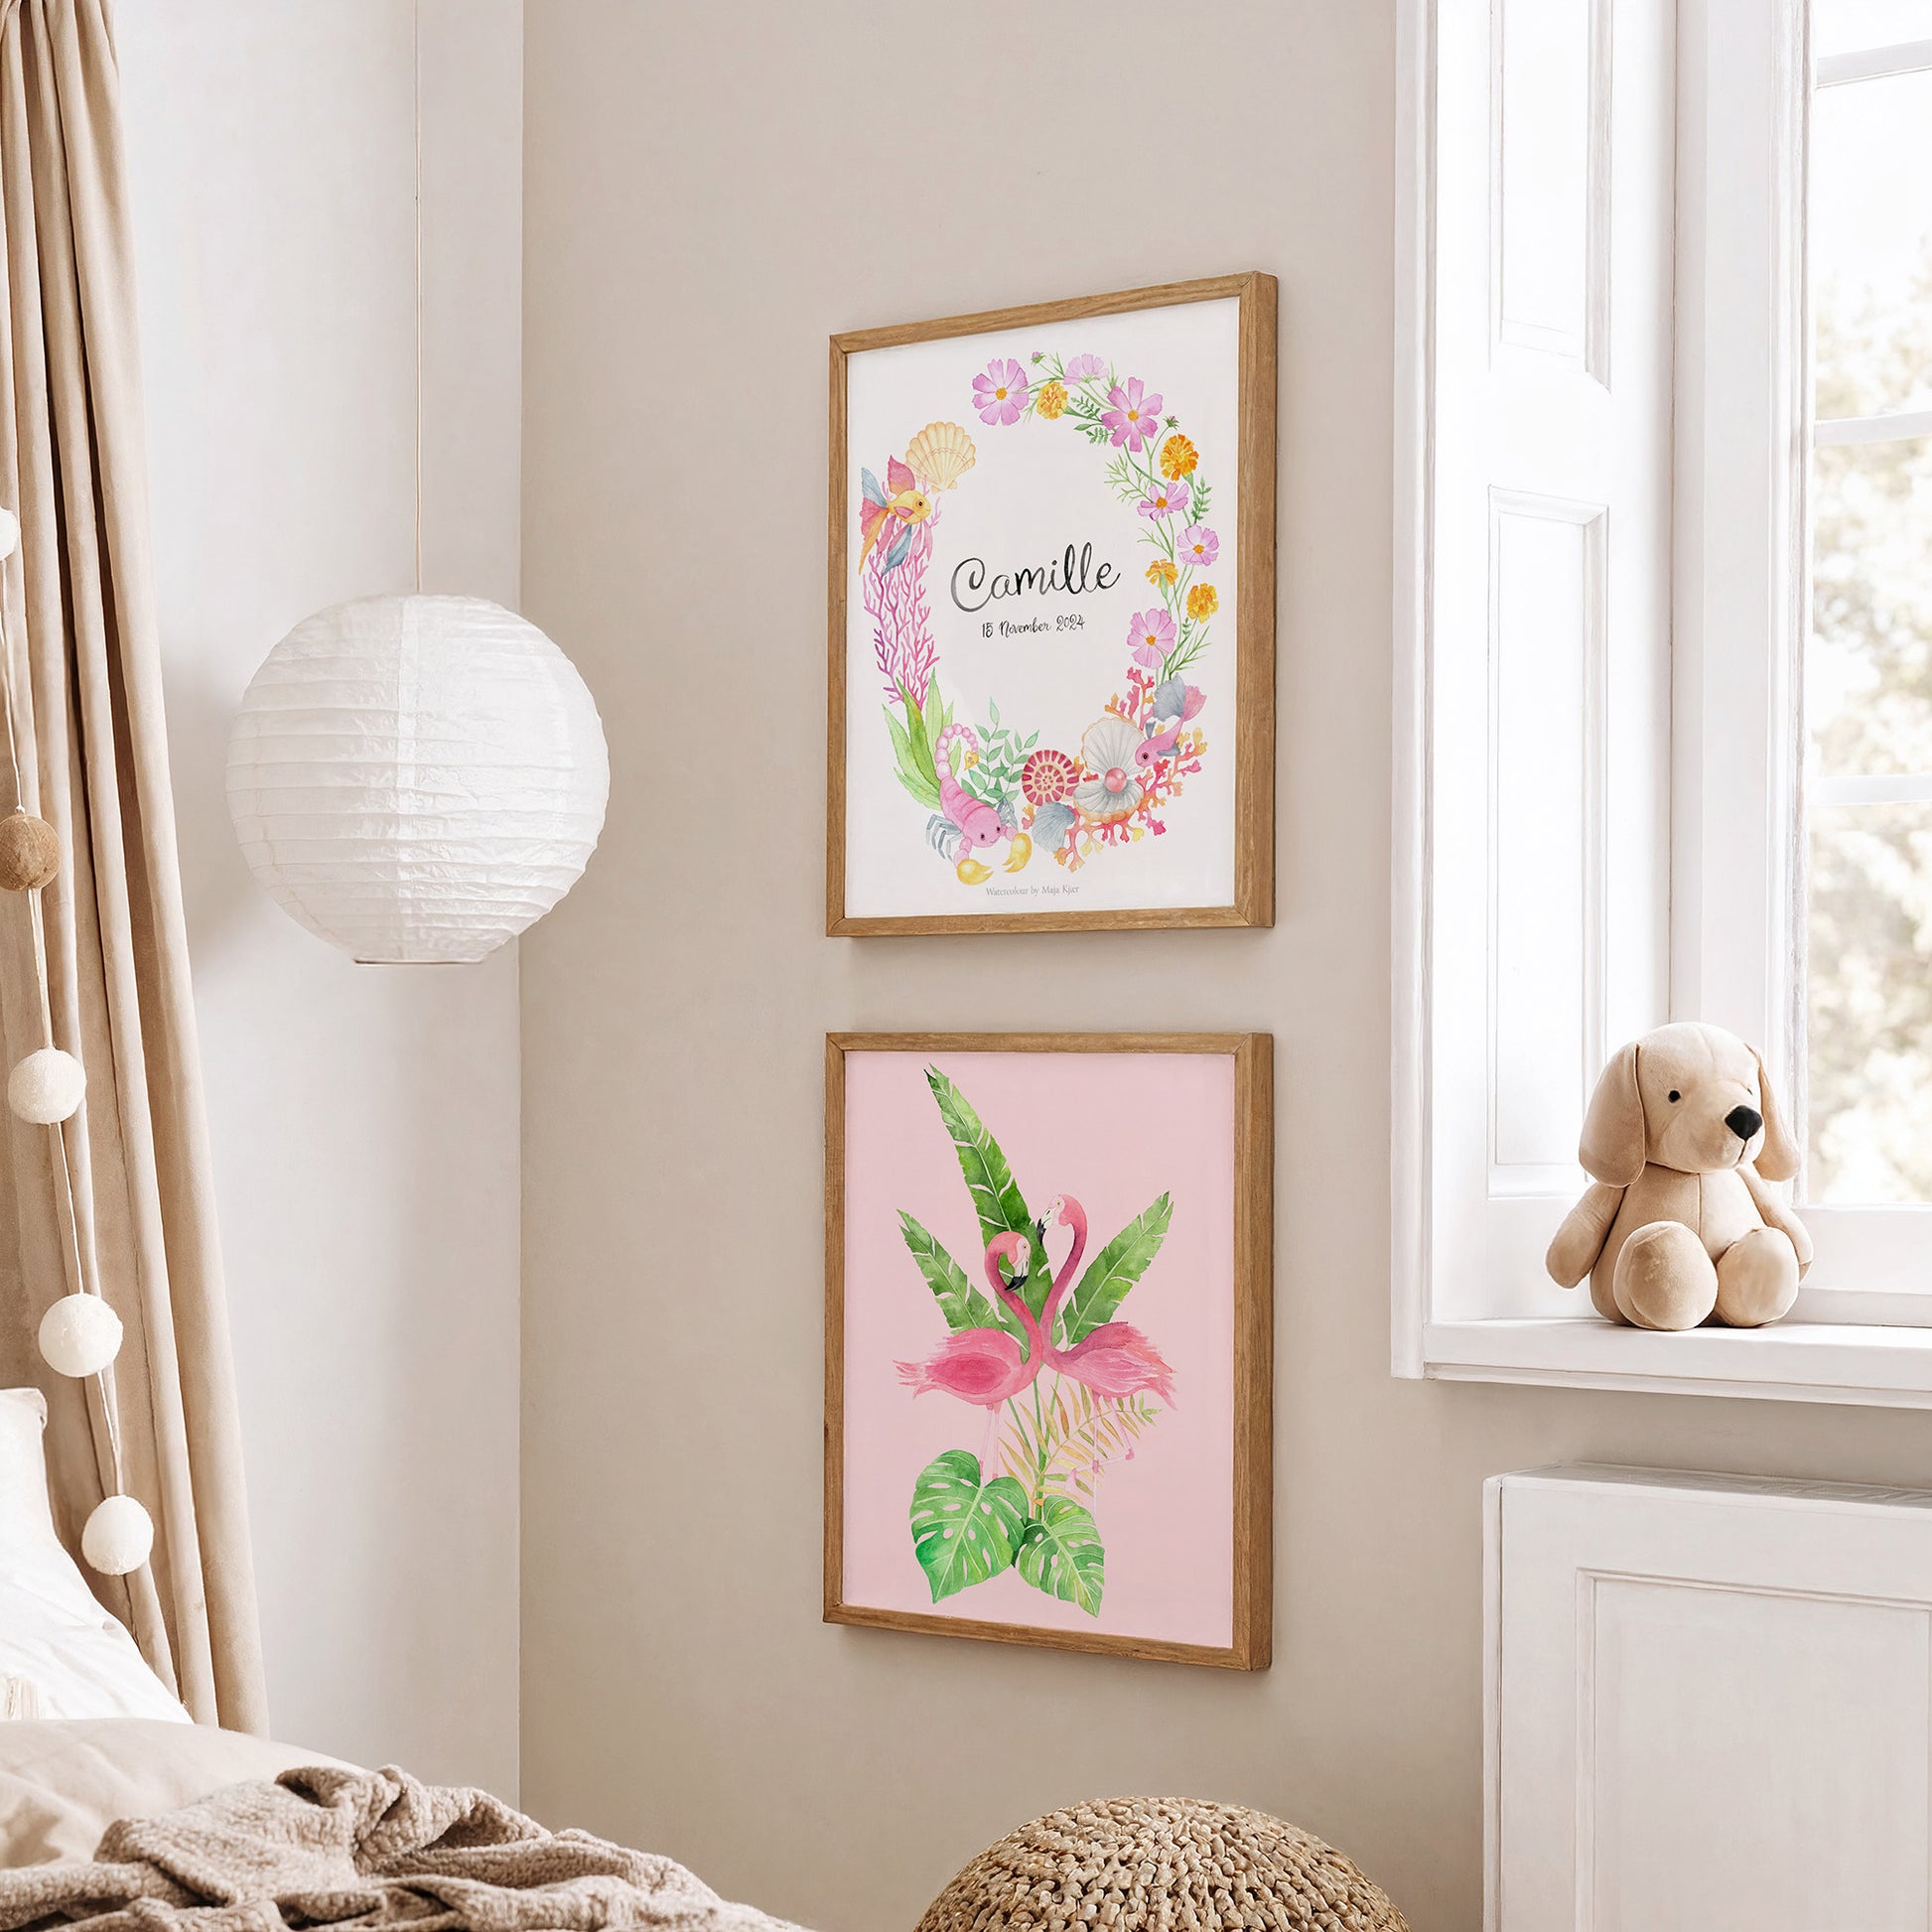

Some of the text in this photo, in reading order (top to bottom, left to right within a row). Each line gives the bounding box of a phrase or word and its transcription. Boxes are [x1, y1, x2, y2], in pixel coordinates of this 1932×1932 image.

[950, 541, 1121, 613] Camille
[982, 614, 1085, 637] 15 November 2024
[986, 887, 1029, 897] Watercolour
[1031, 886, 1040, 897] by
[1041, 885, 1060, 897] Maja
